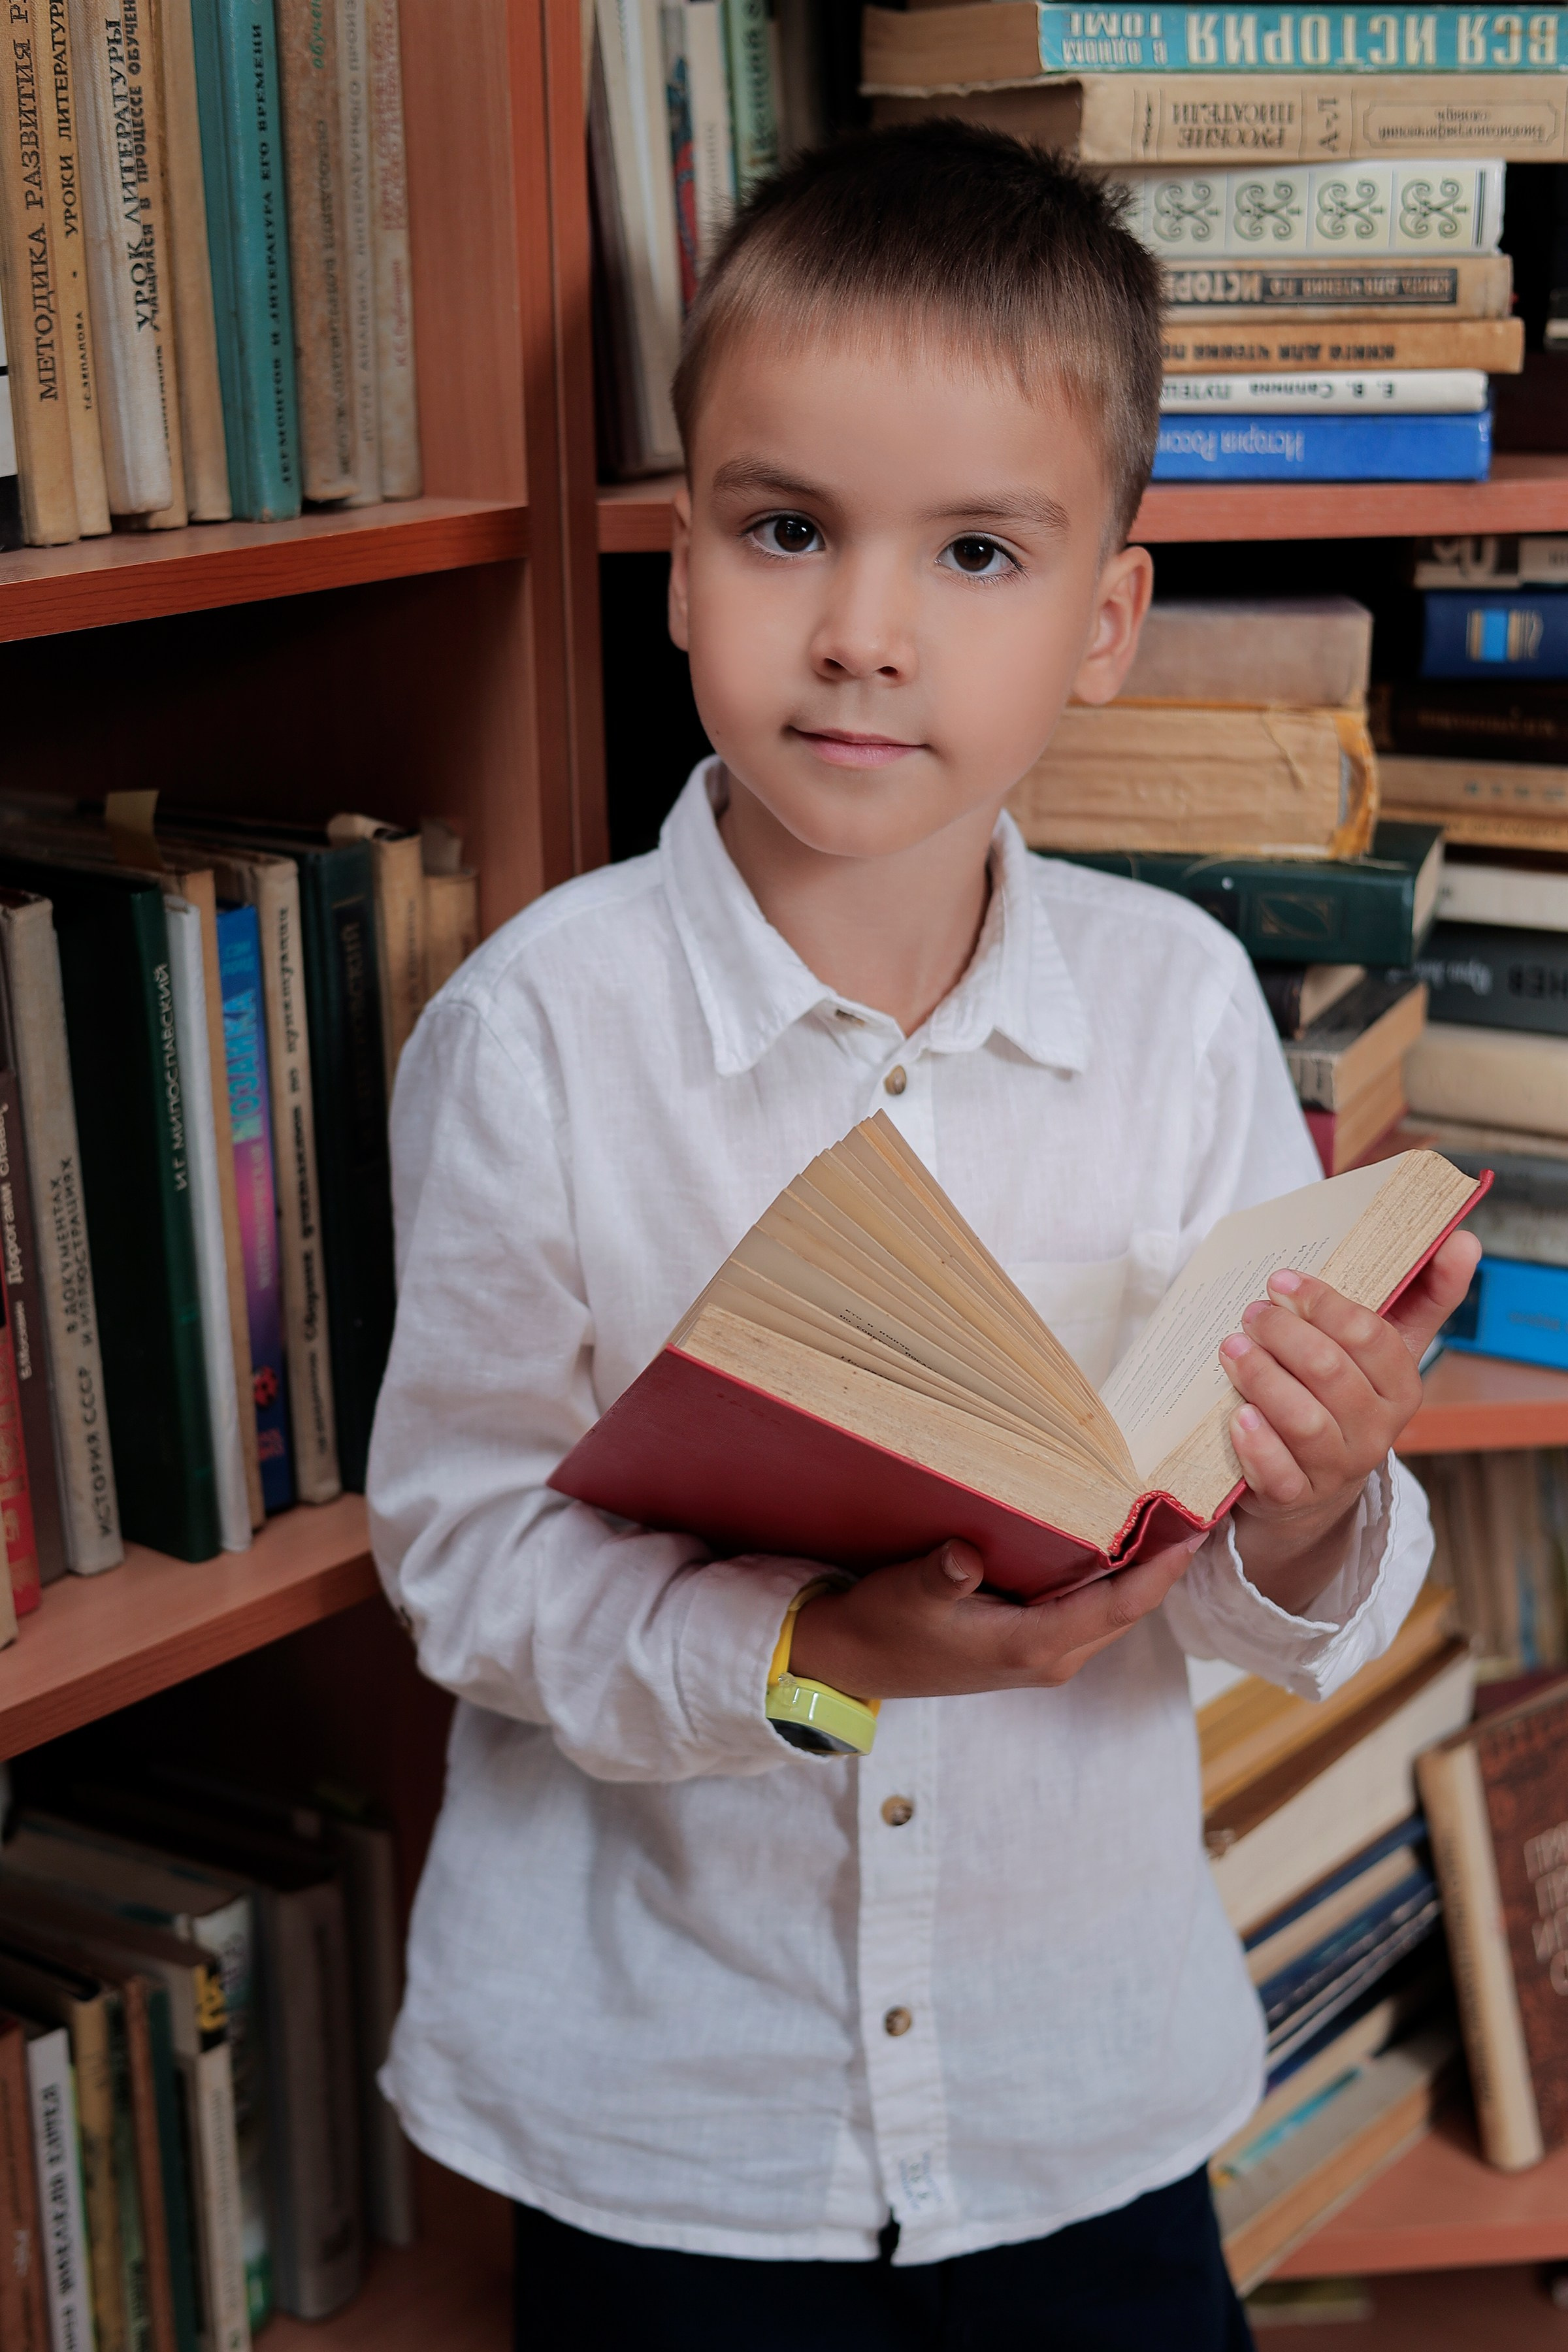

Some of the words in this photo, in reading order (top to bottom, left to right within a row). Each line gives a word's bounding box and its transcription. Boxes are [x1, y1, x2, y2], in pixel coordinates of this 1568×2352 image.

[1062, 38, 1143, 65] ОДНОМ
[1152, 39, 1168, 65] В
[1186, 13, 1437, 65] ИСТОРИЯ
[1457, 13, 1559, 65] ВСЯ
[252, 23, 267, 131] ВРЕМЕНИ
[13, 39, 44, 210] РАЗВИТИЯ
[105, 18, 141, 225] ЛИТЕРАТУРЫ
[1172, 103, 1295, 125] ПИСАТЕЛИ
[128, 86, 150, 184] ПРОЦЕССЕ
[1177, 128, 1286, 150] РУССКИЕ
[257, 142, 271, 180] ЕГО
[59, 155, 78, 238] УРОКИ
[139, 198, 151, 210] В
[262, 191, 282, 325] ЛИТЕРАТУРА
[126, 238, 155, 333] УРОК
[1269, 278, 1296, 297] ПО
[1301, 278, 1362, 297] ЧТЕНИЯ
[1364, 277, 1399, 296] ДЛЯ
[28, 223, 58, 401] МЕТОДИКА
[269, 331, 282, 346] И
[1279, 342, 1322, 362] ДЛЯ
[1249, 382, 1333, 400] Саплина
[1347, 381, 1364, 399] В.
[1377, 381, 1395, 399] Е.
[1220, 423, 1305, 463] История
[50, 1177, 79, 1316] ДОКУМЕНТАХ
[61, 1158, 91, 1325] ИЛЛЮСТРАЦИЯХ
[81, 1331, 94, 1346] И
[78, 1366, 97, 1426] СССР
[86, 1431, 113, 1539] ИСТОРИЯ
